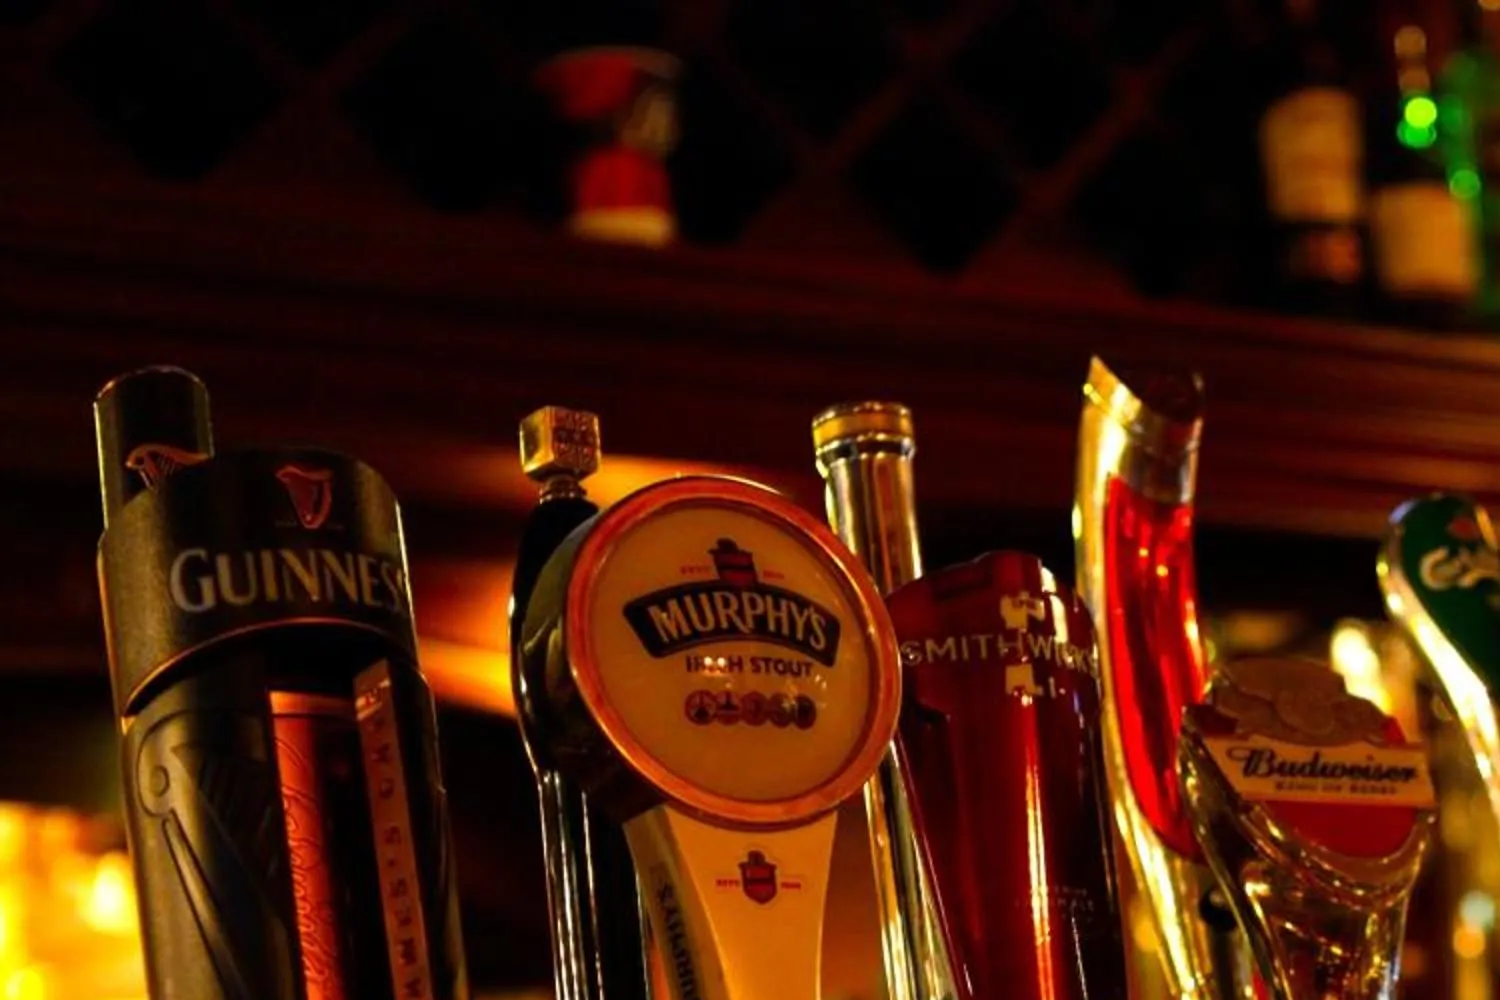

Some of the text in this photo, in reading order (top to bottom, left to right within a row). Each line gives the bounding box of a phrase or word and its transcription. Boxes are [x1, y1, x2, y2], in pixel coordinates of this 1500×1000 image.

[648, 591, 827, 650] MURPHY'S
[750, 656, 813, 678] STOUT
[1226, 747, 1418, 783] Budweiser
